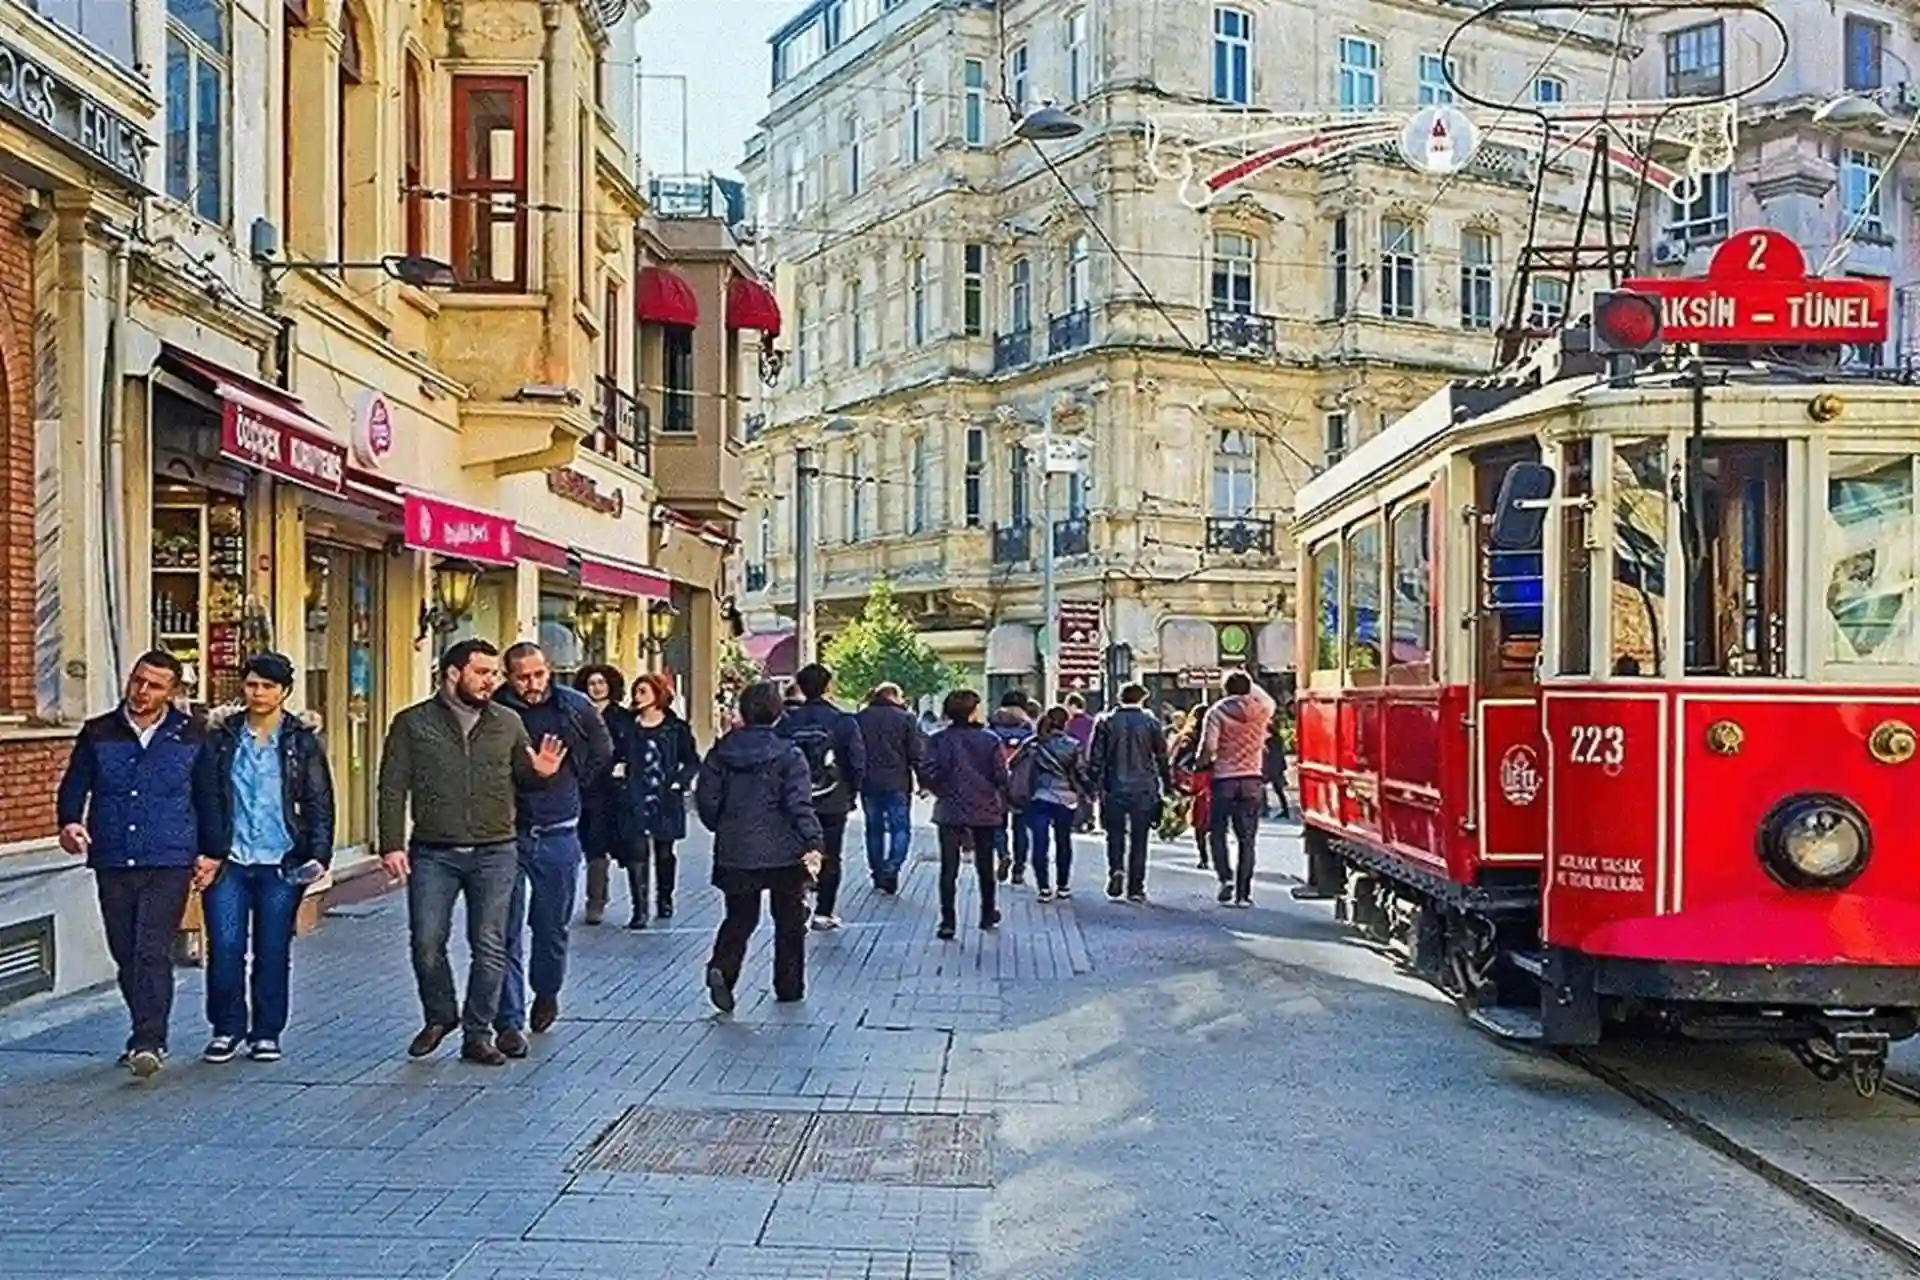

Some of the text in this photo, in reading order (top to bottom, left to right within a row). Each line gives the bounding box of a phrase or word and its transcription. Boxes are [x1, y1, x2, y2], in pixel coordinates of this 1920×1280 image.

[80, 98, 144, 182] FRIES
[1747, 235, 1768, 271] 2
[1661, 289, 1736, 328] AKSİM
[1786, 291, 1879, 328] TÜNEL
[1571, 726, 1624, 764] 223
